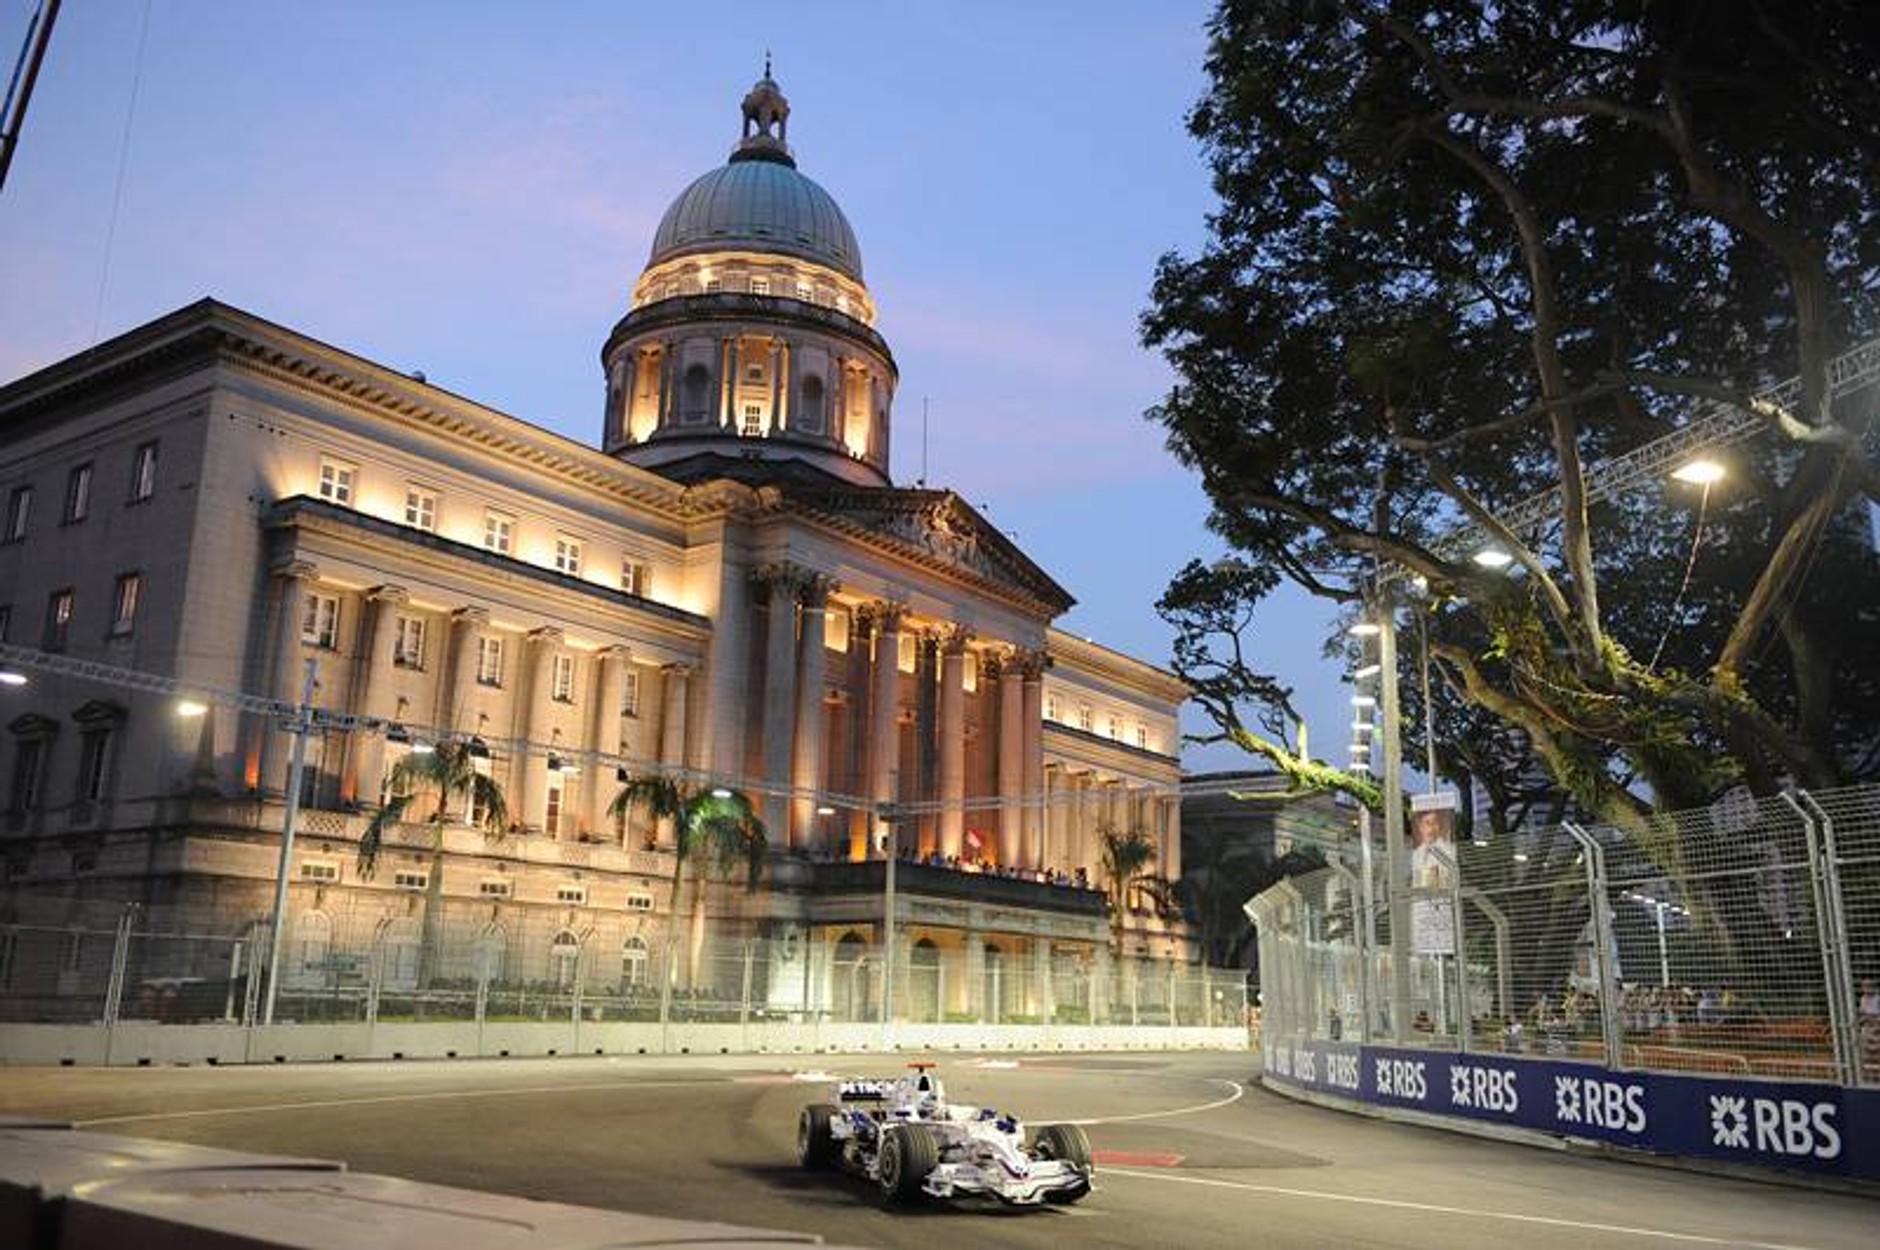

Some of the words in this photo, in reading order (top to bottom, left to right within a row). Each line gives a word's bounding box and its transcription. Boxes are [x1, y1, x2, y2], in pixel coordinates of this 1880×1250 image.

[1337, 1053, 1359, 1090] RBS
[1393, 1060, 1426, 1099] RBS
[1473, 1067, 1518, 1113] RBS
[1584, 1079, 1647, 1133] RBS
[1753, 1099, 1842, 1159] RBS
